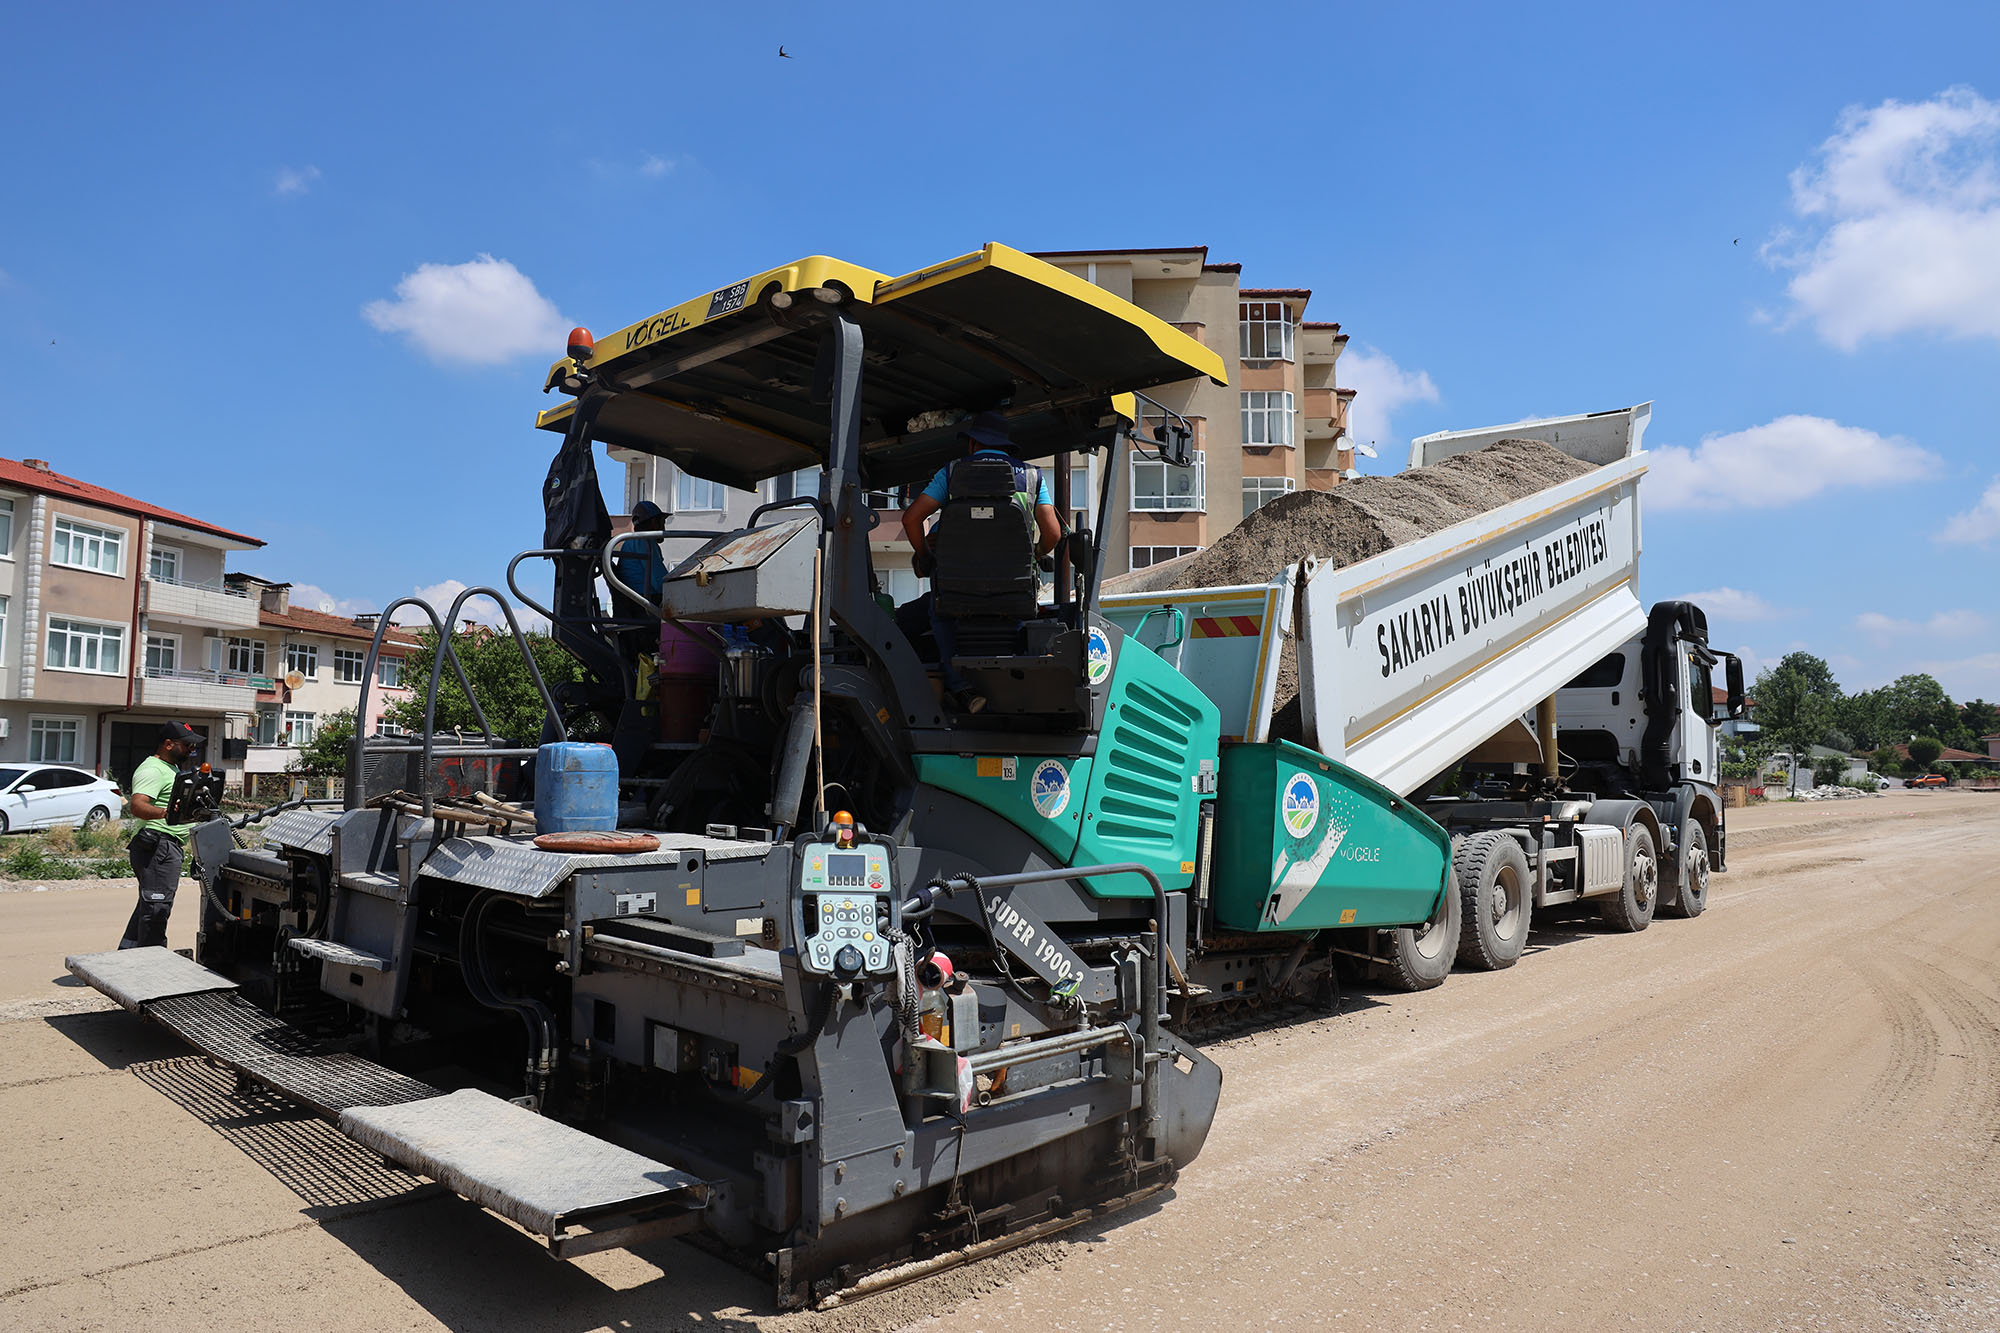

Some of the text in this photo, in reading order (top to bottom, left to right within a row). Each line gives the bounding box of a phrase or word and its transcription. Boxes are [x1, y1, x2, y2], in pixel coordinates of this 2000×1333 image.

[713, 284, 747, 303] 54 SBB
[721, 297, 742, 312] 1574
[1376, 506, 1609, 679] SAKARYA BÜYÜKŞEHİR BELEDİYESİ
[1340, 843, 1381, 862] VÖGELE
[986, 895, 1035, 948] SUPER
